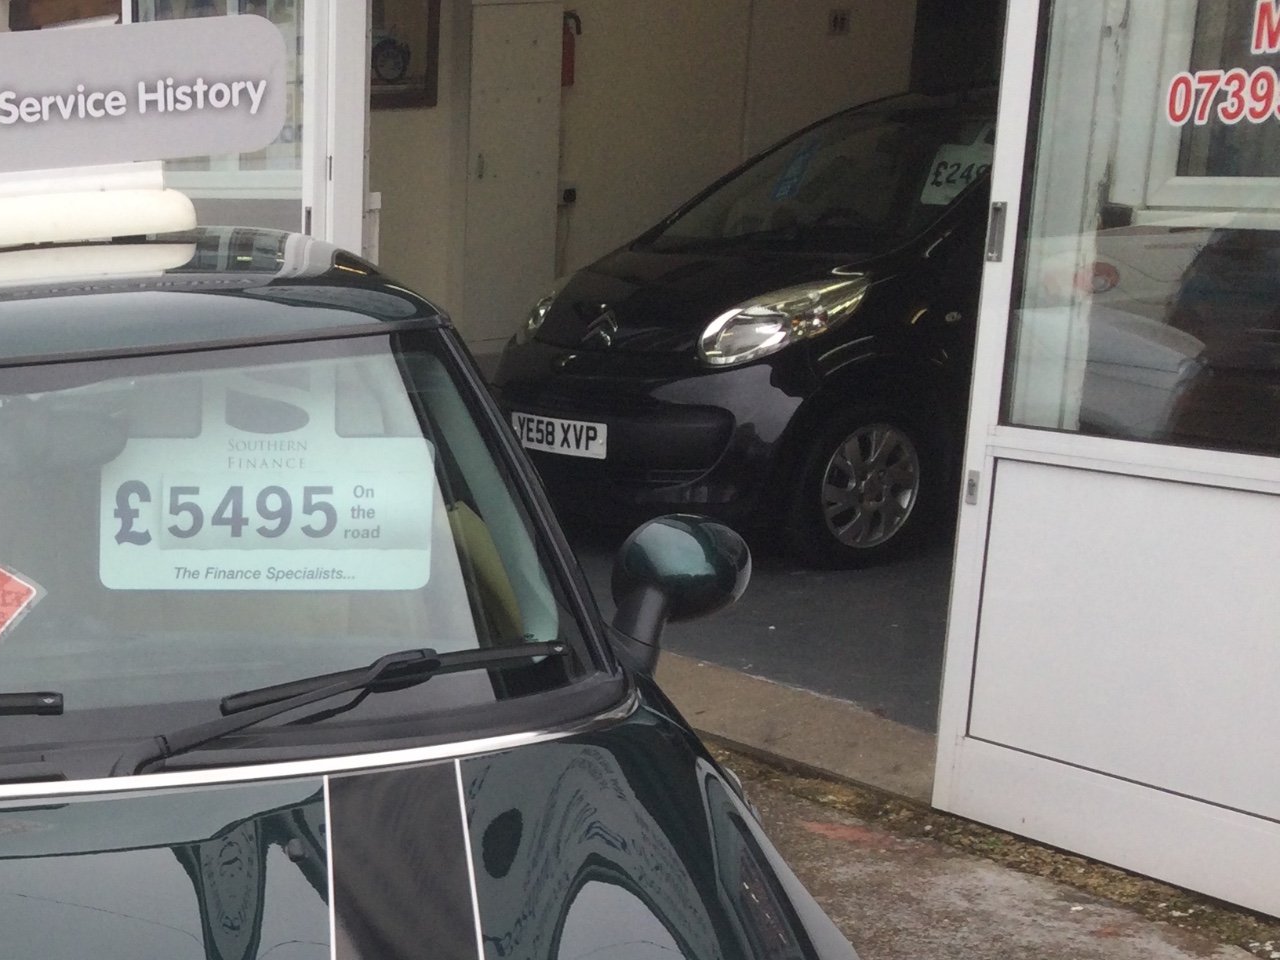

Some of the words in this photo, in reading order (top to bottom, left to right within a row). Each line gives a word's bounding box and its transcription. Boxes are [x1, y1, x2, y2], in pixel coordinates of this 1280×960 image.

[137, 77, 268, 115] History
[1168, 70, 1280, 123] 0739
[560, 421, 599, 452] XVP
[227, 438, 308, 451] SOUTHERN
[227, 457, 307, 470] FINANCE
[353, 485, 375, 499] On
[350, 505, 376, 519] the
[344, 525, 380, 539] road
[175, 567, 200, 580] The
[204, 567, 261, 580] Finance
